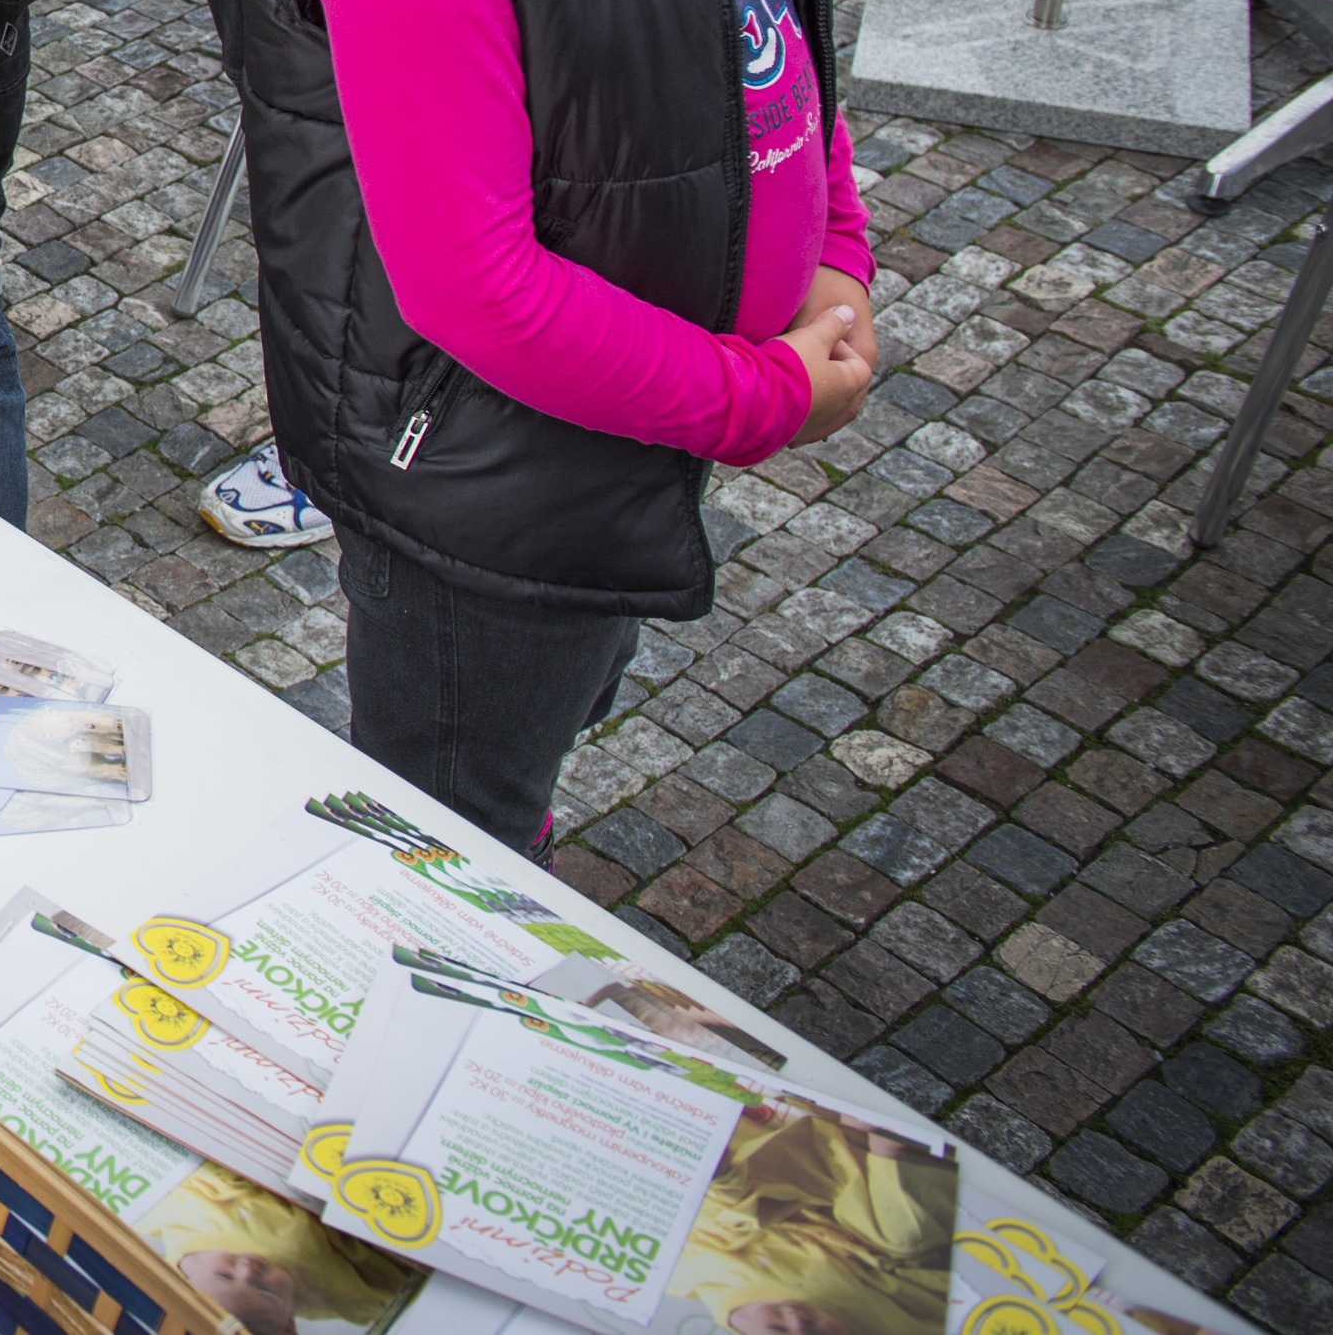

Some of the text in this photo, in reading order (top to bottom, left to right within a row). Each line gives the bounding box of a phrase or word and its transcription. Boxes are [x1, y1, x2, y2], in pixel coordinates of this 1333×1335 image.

[314, 866, 333, 884] Kč
[329, 877, 347, 894] 20
[396, 864, 458, 915] děkujeme.
[310, 880, 345, 908] 30 Kč
[368, 891, 402, 920] zlepšit
[400, 915, 439, 948] pomoci
[455, 908, 485, 934] vám
[253, 917, 351, 994] nemocným dětem,
[436, 941, 454, 957] Vy
[483, 926, 535, 969] Srdečně
[252, 930, 341, 999] na pomoc vážně
[230, 937, 356, 1036] DÍČKOVÉ
[42, 993, 78, 1023] 20 Kč
[39, 1009, 77, 1041] 30 Kč
[209, 1036, 322, 1103] dzimní
[463, 1058, 483, 1075] Kč
[535, 1034, 616, 1081] děkujeme.
[466, 1074, 489, 1093] Kč
[482, 1066, 503, 1084] 20
[525, 1074, 570, 1103] zlepšit
[615, 1072, 653, 1098] vám
[488, 1084, 510, 1101] 30
[515, 1081, 550, 1106] klipu
[653, 1088, 719, 1128] Srdečně
[15, 1100, 59, 1137] pomoc
[19, 1087, 86, 1142] nemocným
[523, 1099, 598, 1144] magnetky
[547, 1096, 626, 1143] plastového
[571, 1095, 622, 1127] pomoci
[622, 1119, 641, 1135] Vy
[55, 1132, 75, 1151] na
[648, 1132, 703, 1165] můžete
[72, 1145, 152, 1203] DNY
[435, 1134, 573, 1208] nemocným dětem,
[597, 1133, 694, 1189] Zakoupením
[445, 1152, 663, 1262] DNY na pomoc vážně
[437, 1171, 648, 1284] SRDÍČKOVÉ
[450, 1216, 640, 1302] Podzimní
